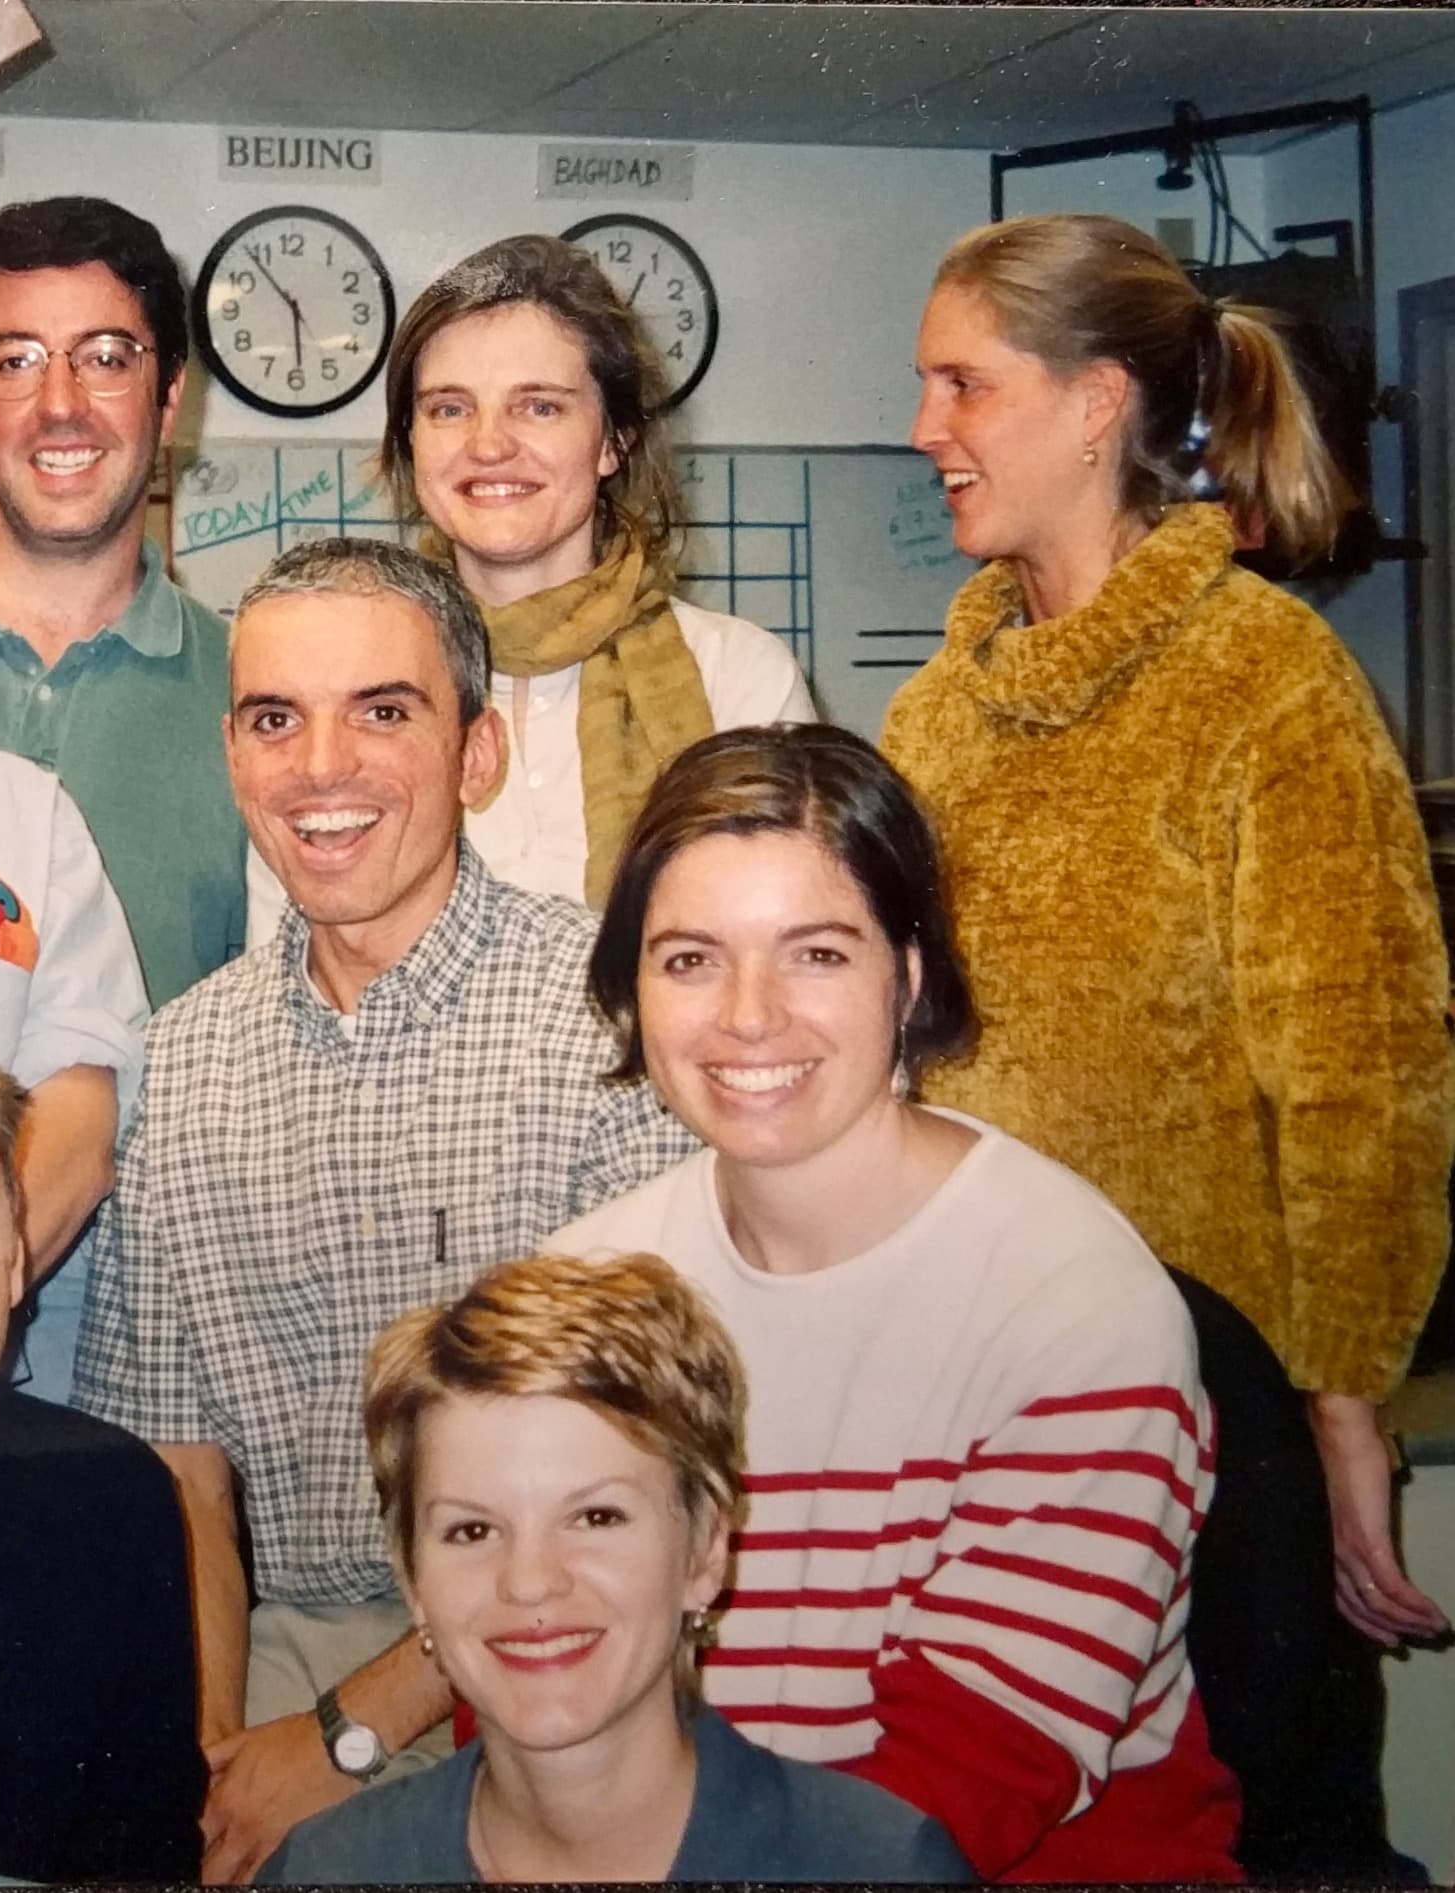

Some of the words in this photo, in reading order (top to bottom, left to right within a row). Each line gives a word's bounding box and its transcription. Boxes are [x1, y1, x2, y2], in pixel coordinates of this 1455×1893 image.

[226, 136, 373, 170] BEIJING
[554, 156, 662, 187] BAGHDAD
[280, 233, 305, 257] 12
[325, 244, 333, 266] 1
[608, 241, 631, 263] 12
[651, 252, 659, 274] 1
[229, 271, 256, 294] 10
[342, 272, 359, 294] 2
[667, 280, 683, 301] 2
[221, 300, 240, 321] 9
[352, 302, 370, 325] 3
[677, 310, 693, 332] 3
[234, 330, 252, 352] 8
[344, 334, 359, 355] 4
[667, 338, 683, 360] 4
[260, 356, 276, 378] 7
[320, 359, 339, 381] 5
[287, 368, 305, 391] 6
[184, 491, 271, 547] TODAY
[281, 469, 333, 517] TIME
